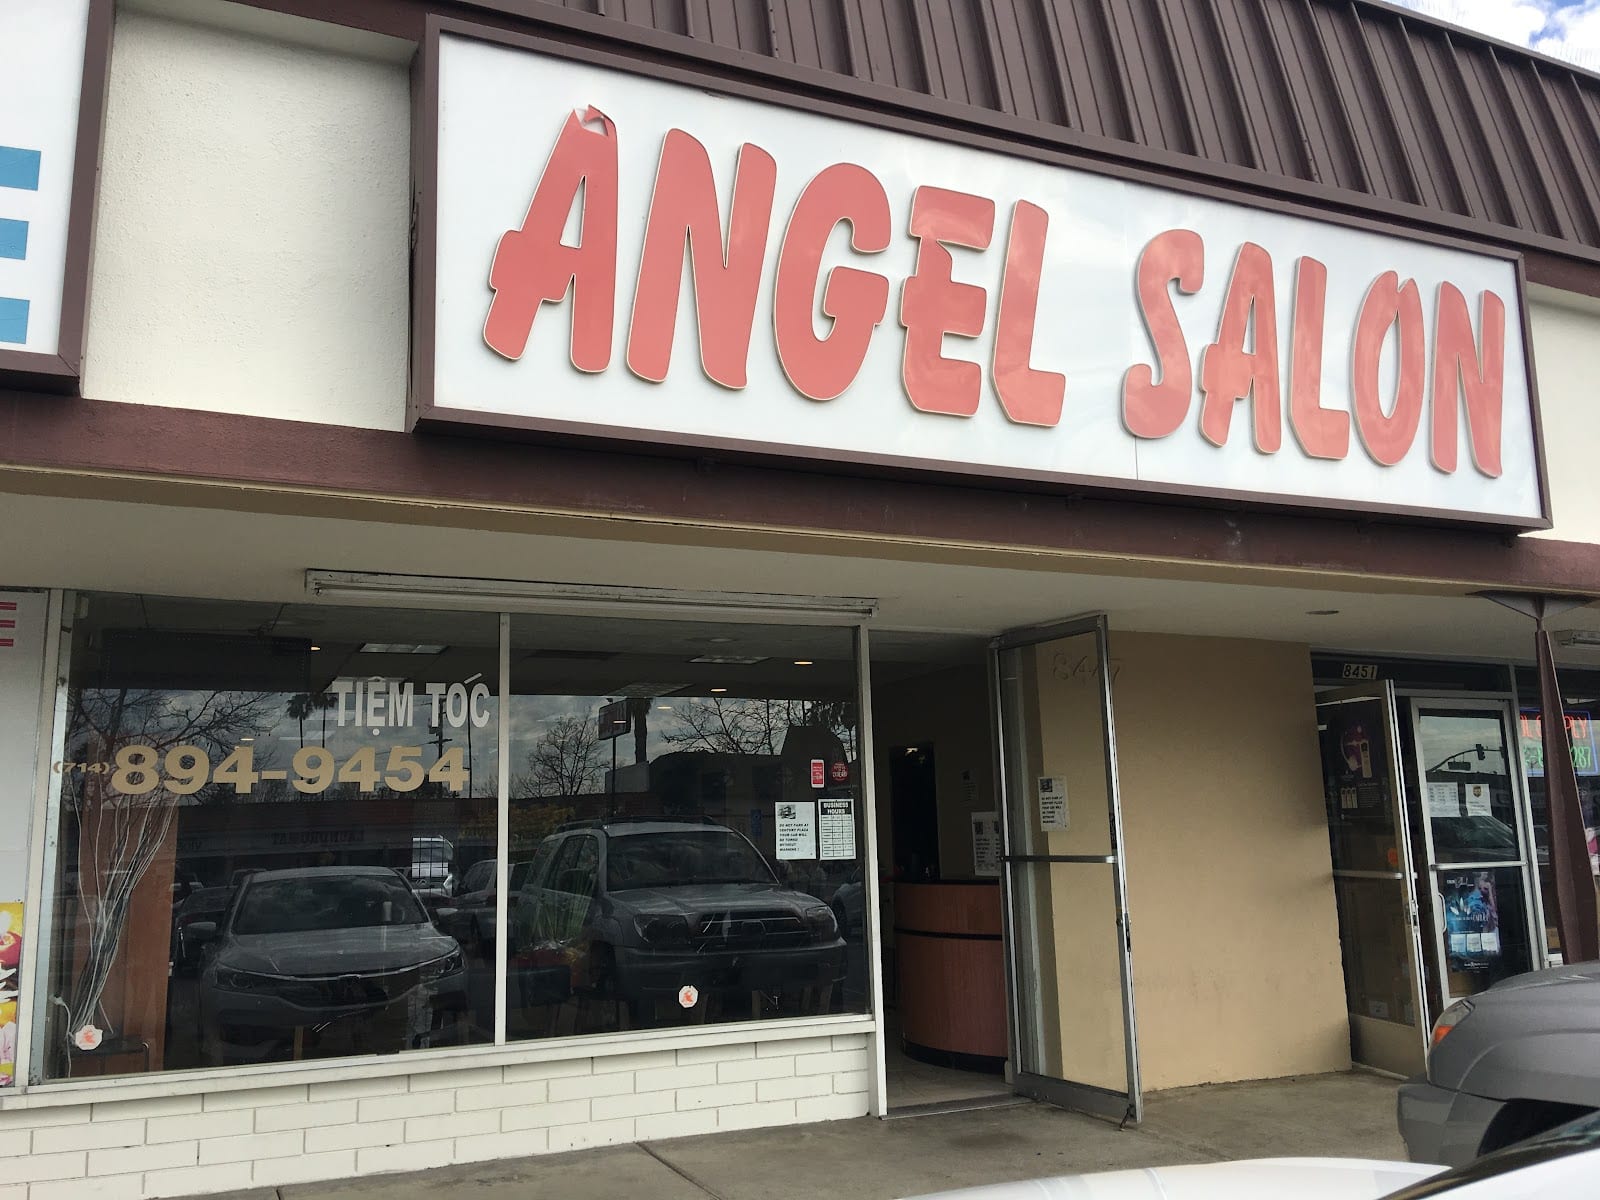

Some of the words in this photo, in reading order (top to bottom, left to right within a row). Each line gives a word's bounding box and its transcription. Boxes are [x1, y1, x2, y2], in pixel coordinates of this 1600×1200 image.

[482, 103, 1067, 428] ANGEL
[1122, 228, 1506, 479] SALON
[1344, 664, 1376, 679] 8451
[53, 761, 110, 774] (714)
[111, 744, 470, 795] 894-9454
